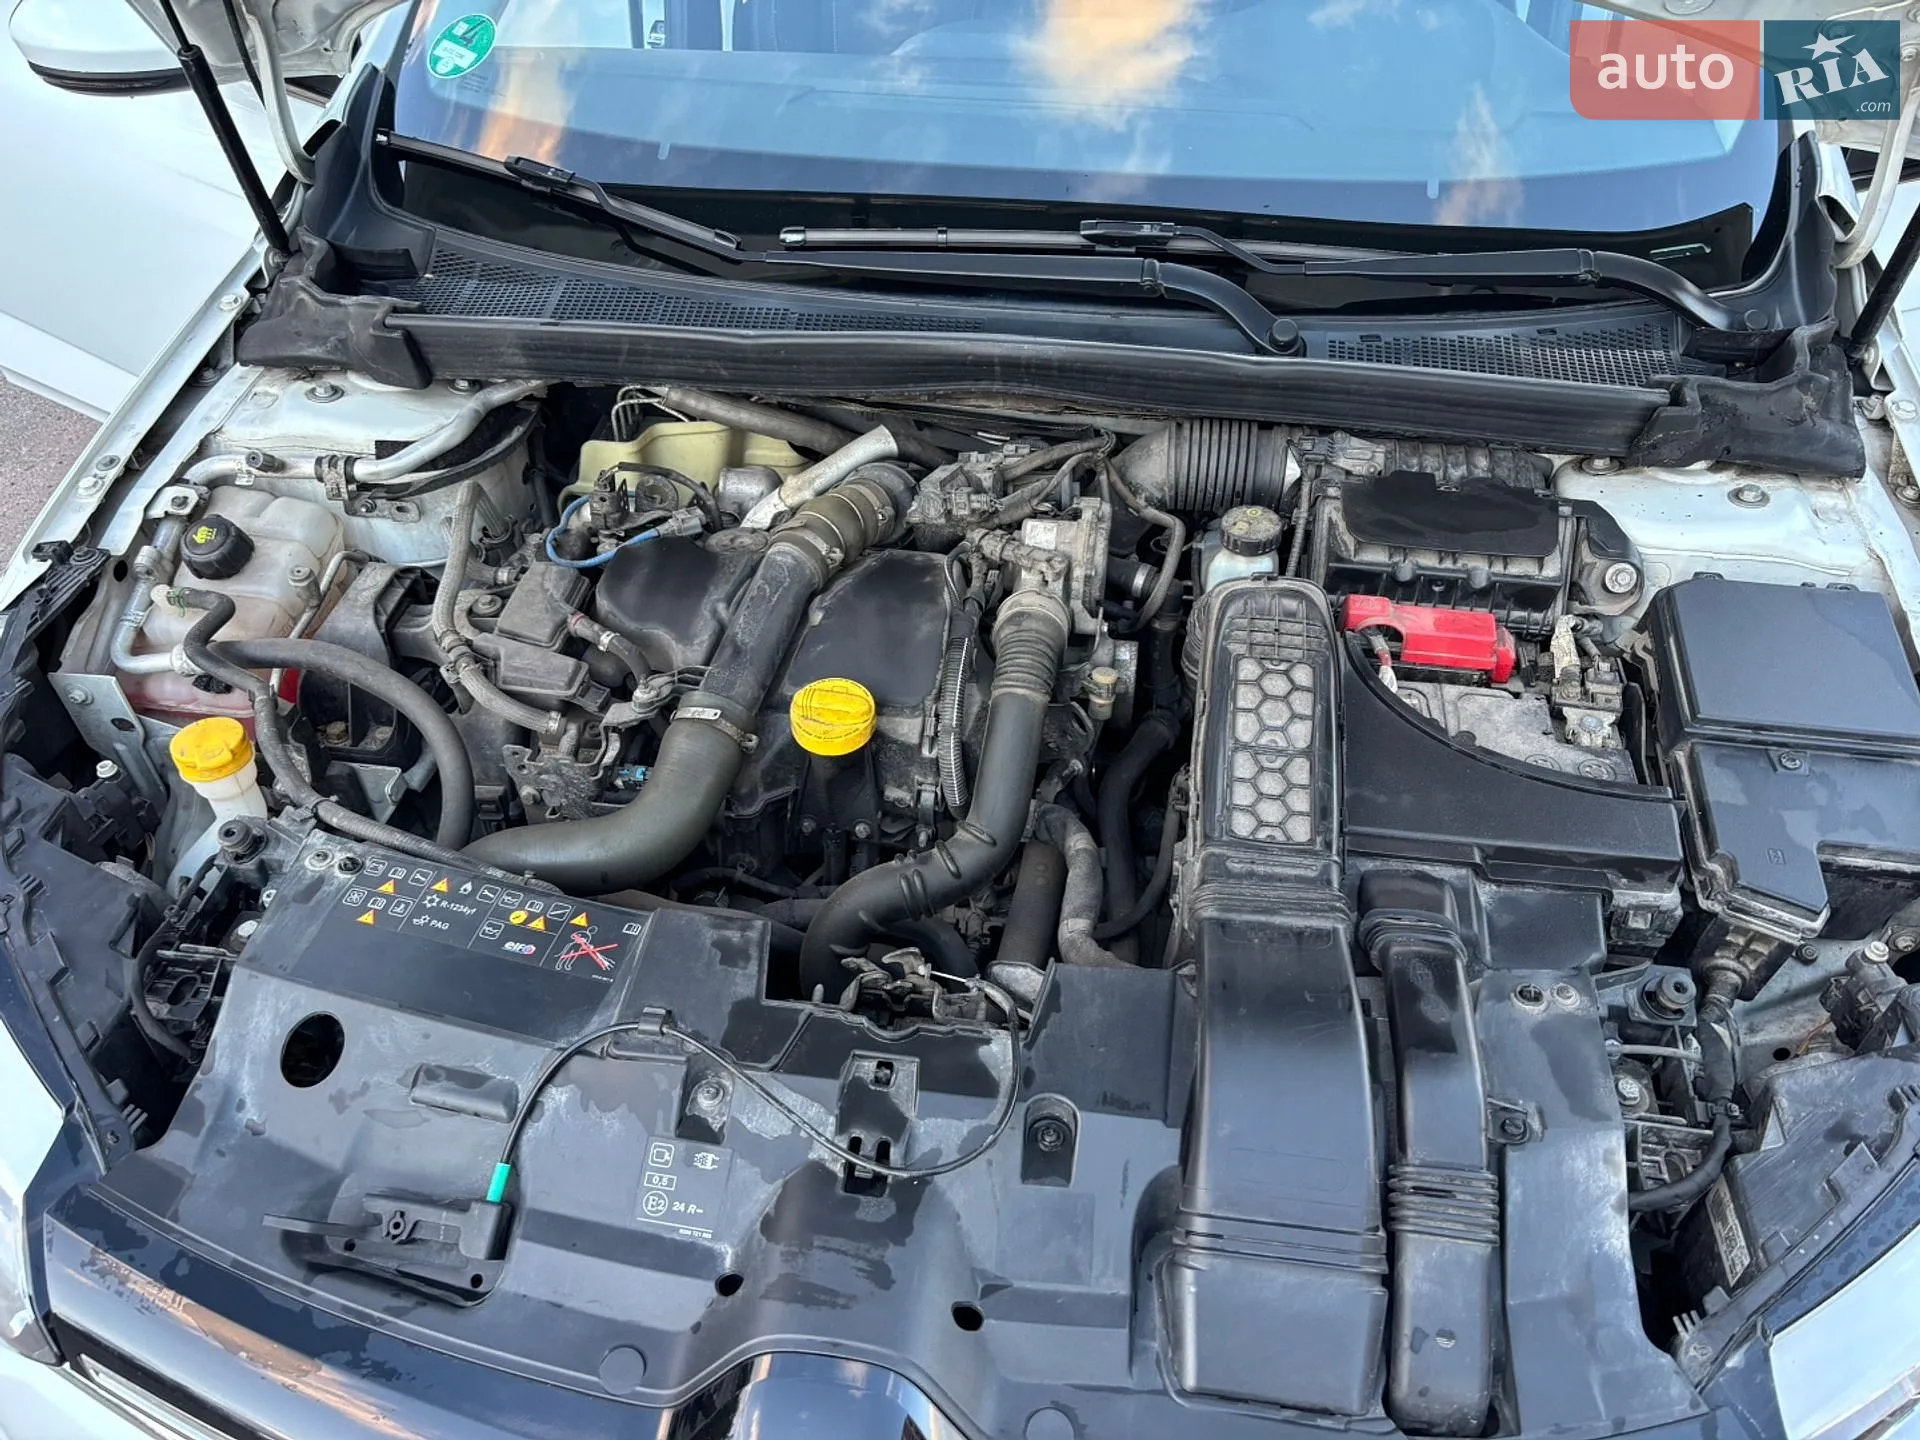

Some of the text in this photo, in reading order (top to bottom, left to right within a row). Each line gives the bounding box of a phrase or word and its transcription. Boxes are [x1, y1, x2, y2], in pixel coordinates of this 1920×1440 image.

[459, 20, 486, 46] 4
[429, 919, 450, 930] PAG
[503, 941, 526, 954] elf
[647, 1195, 665, 1211] E2
[672, 1201, 686, 1212] 24
